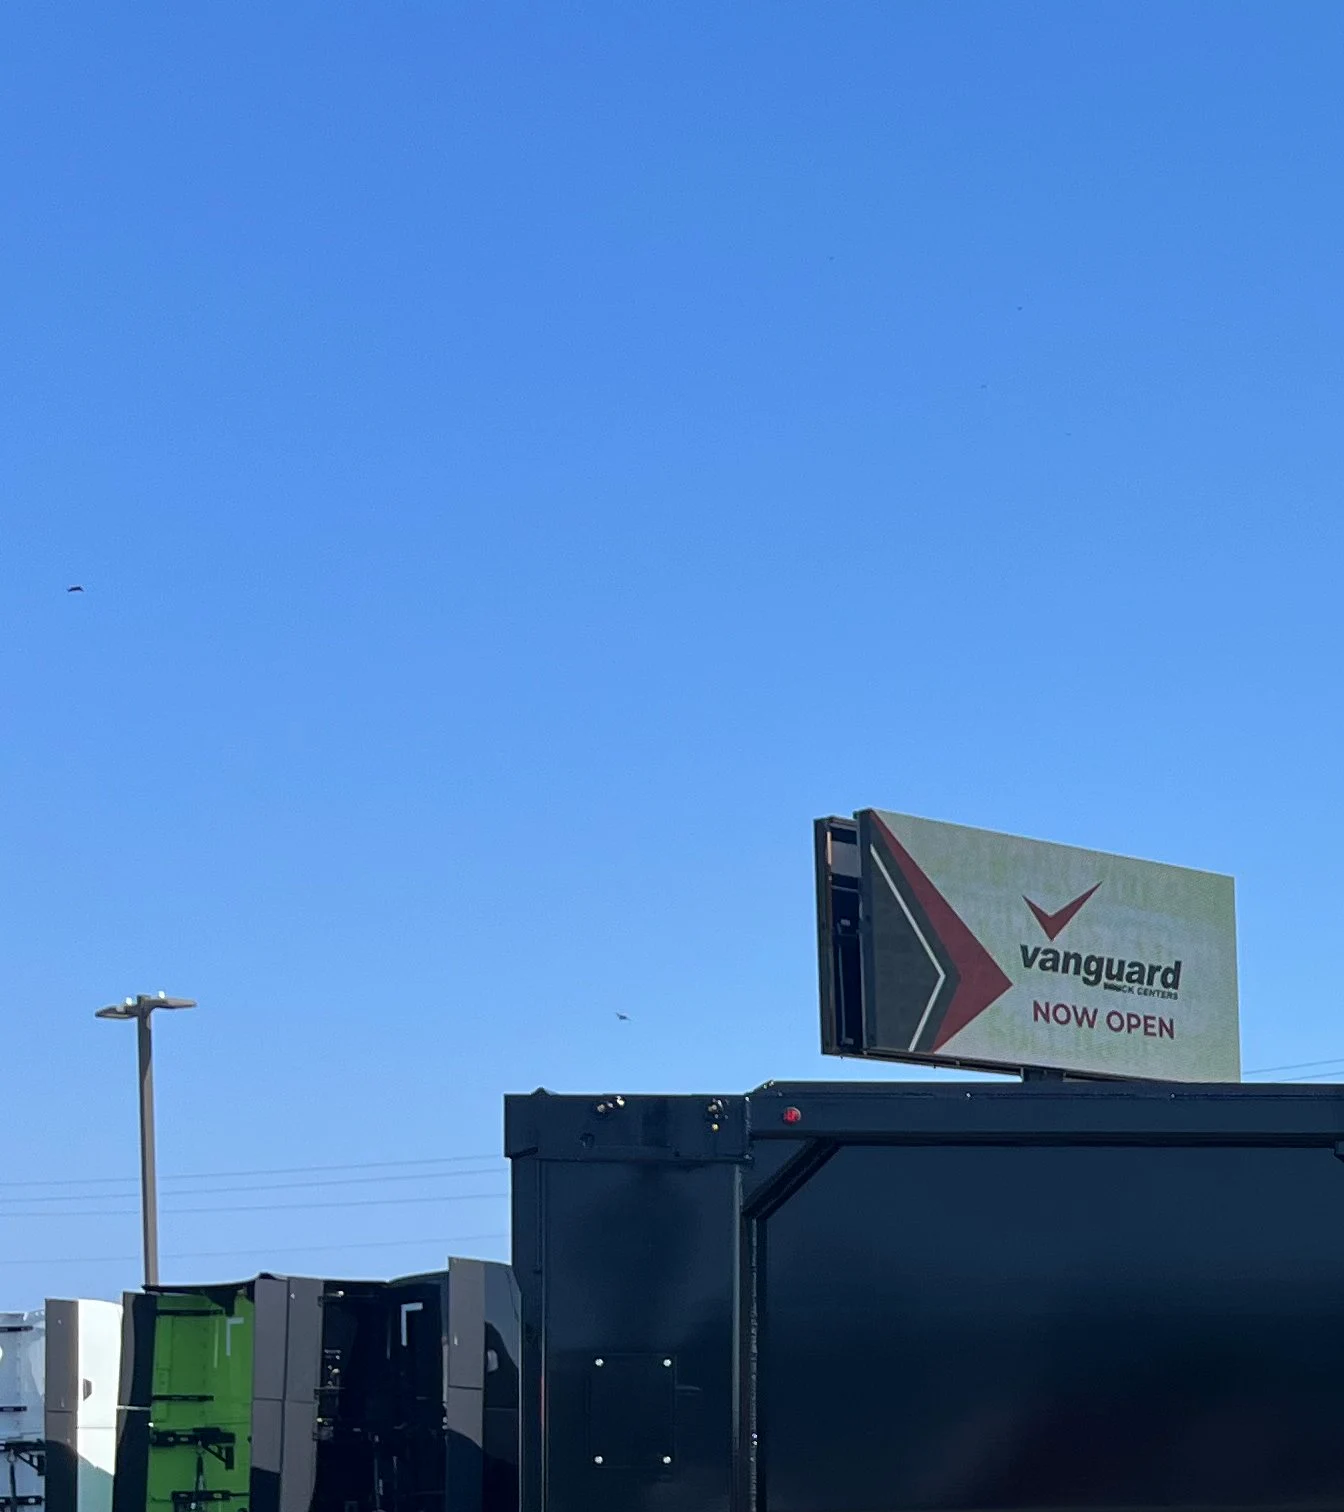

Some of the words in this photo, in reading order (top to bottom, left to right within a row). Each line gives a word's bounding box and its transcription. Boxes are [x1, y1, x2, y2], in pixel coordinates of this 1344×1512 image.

[1020, 943, 1182, 990] vanguard
[1033, 1000, 1098, 1029] NOW
[1107, 1011, 1175, 1040] OPEN
